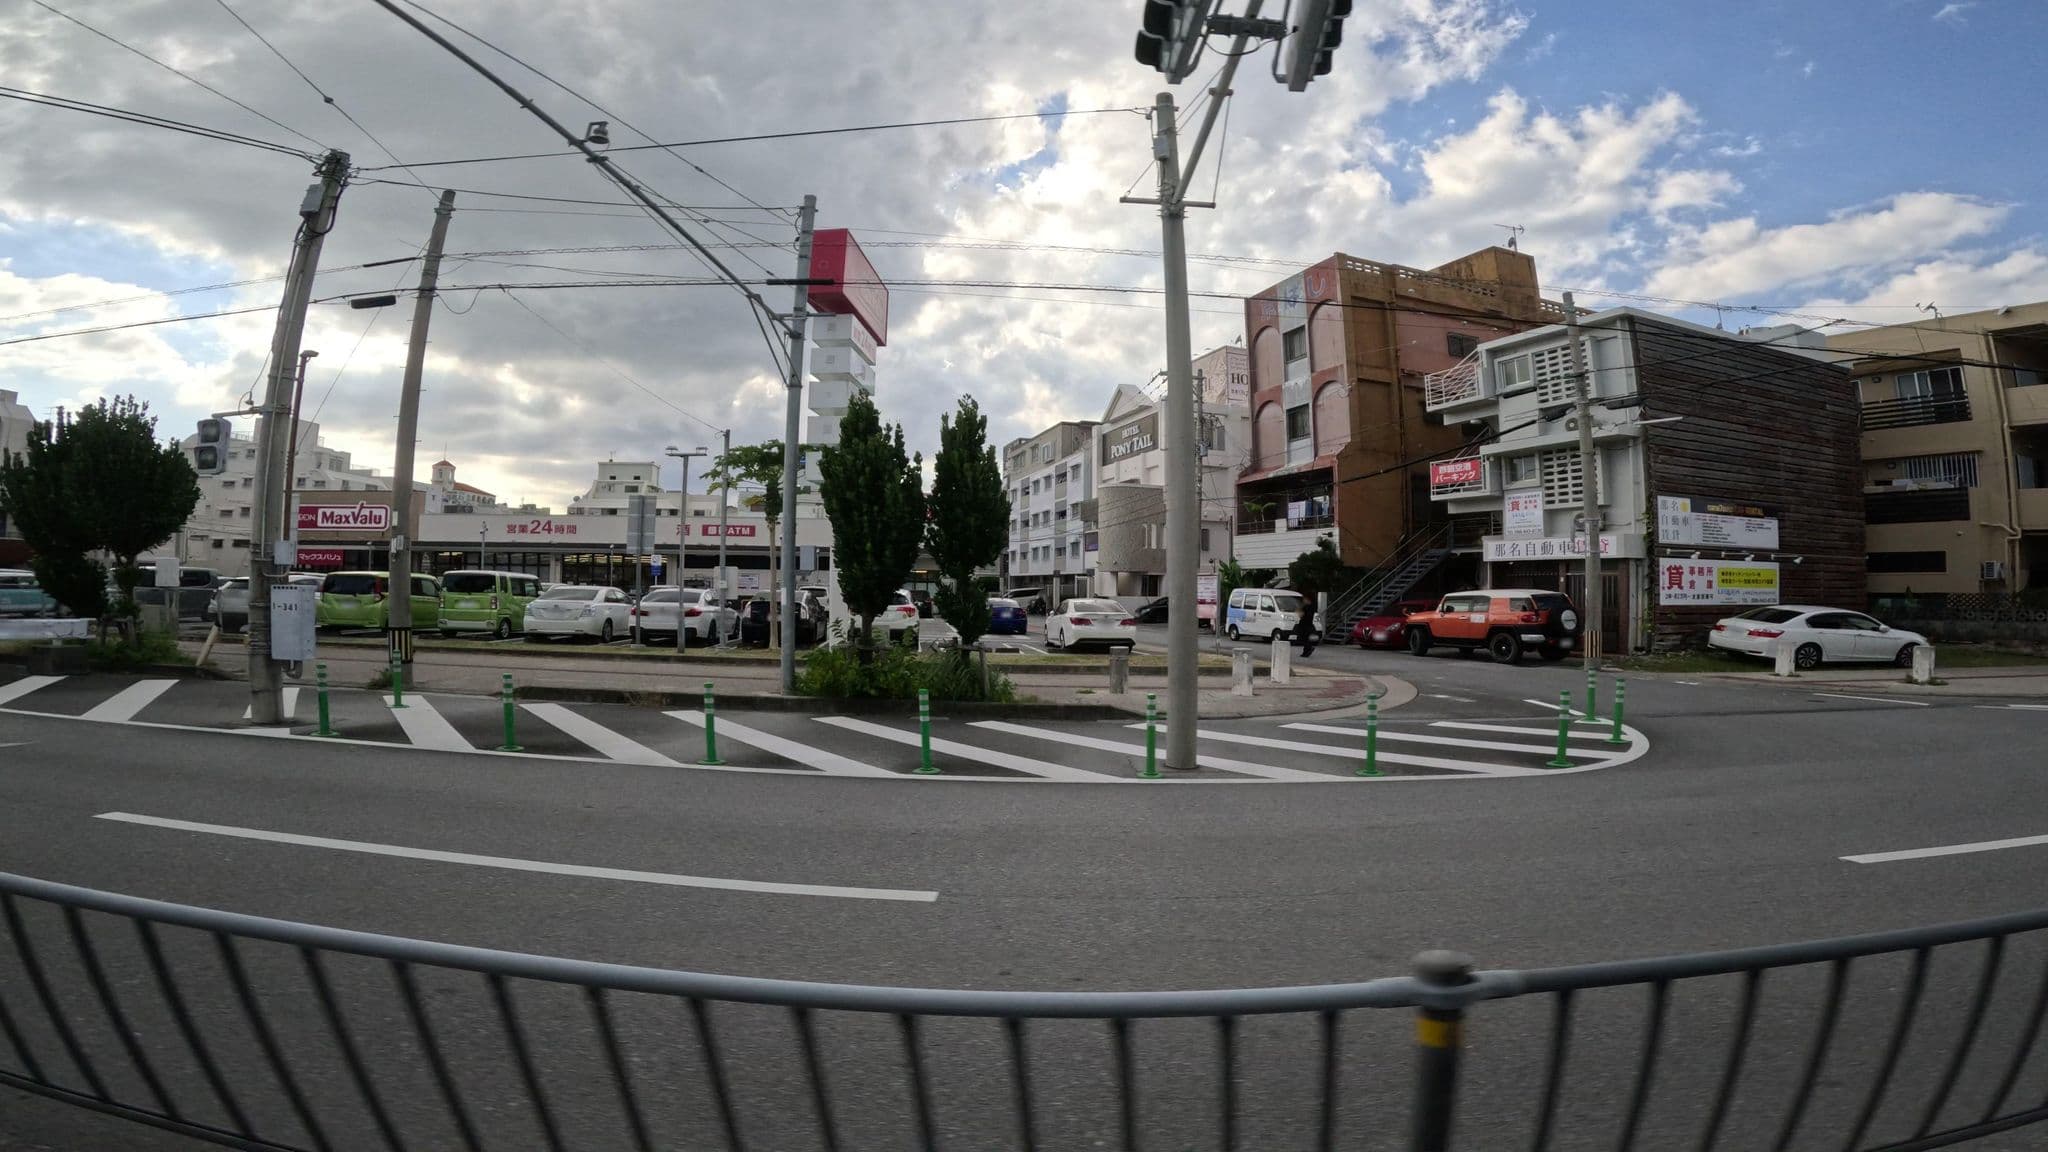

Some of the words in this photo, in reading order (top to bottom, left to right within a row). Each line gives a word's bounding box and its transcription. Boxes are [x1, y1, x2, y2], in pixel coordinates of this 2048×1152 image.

[1121, 424, 1140, 439] HOTEL
[1111, 440, 1132, 458] PONY
[1132, 433, 1153, 451] TAIL
[1435, 470, 1476, 483] パーキング
[320, 504, 383, 525] MaxValu
[506, 519, 577, 535] 営業24時間
[1665, 564, 1685, 591] 貸
